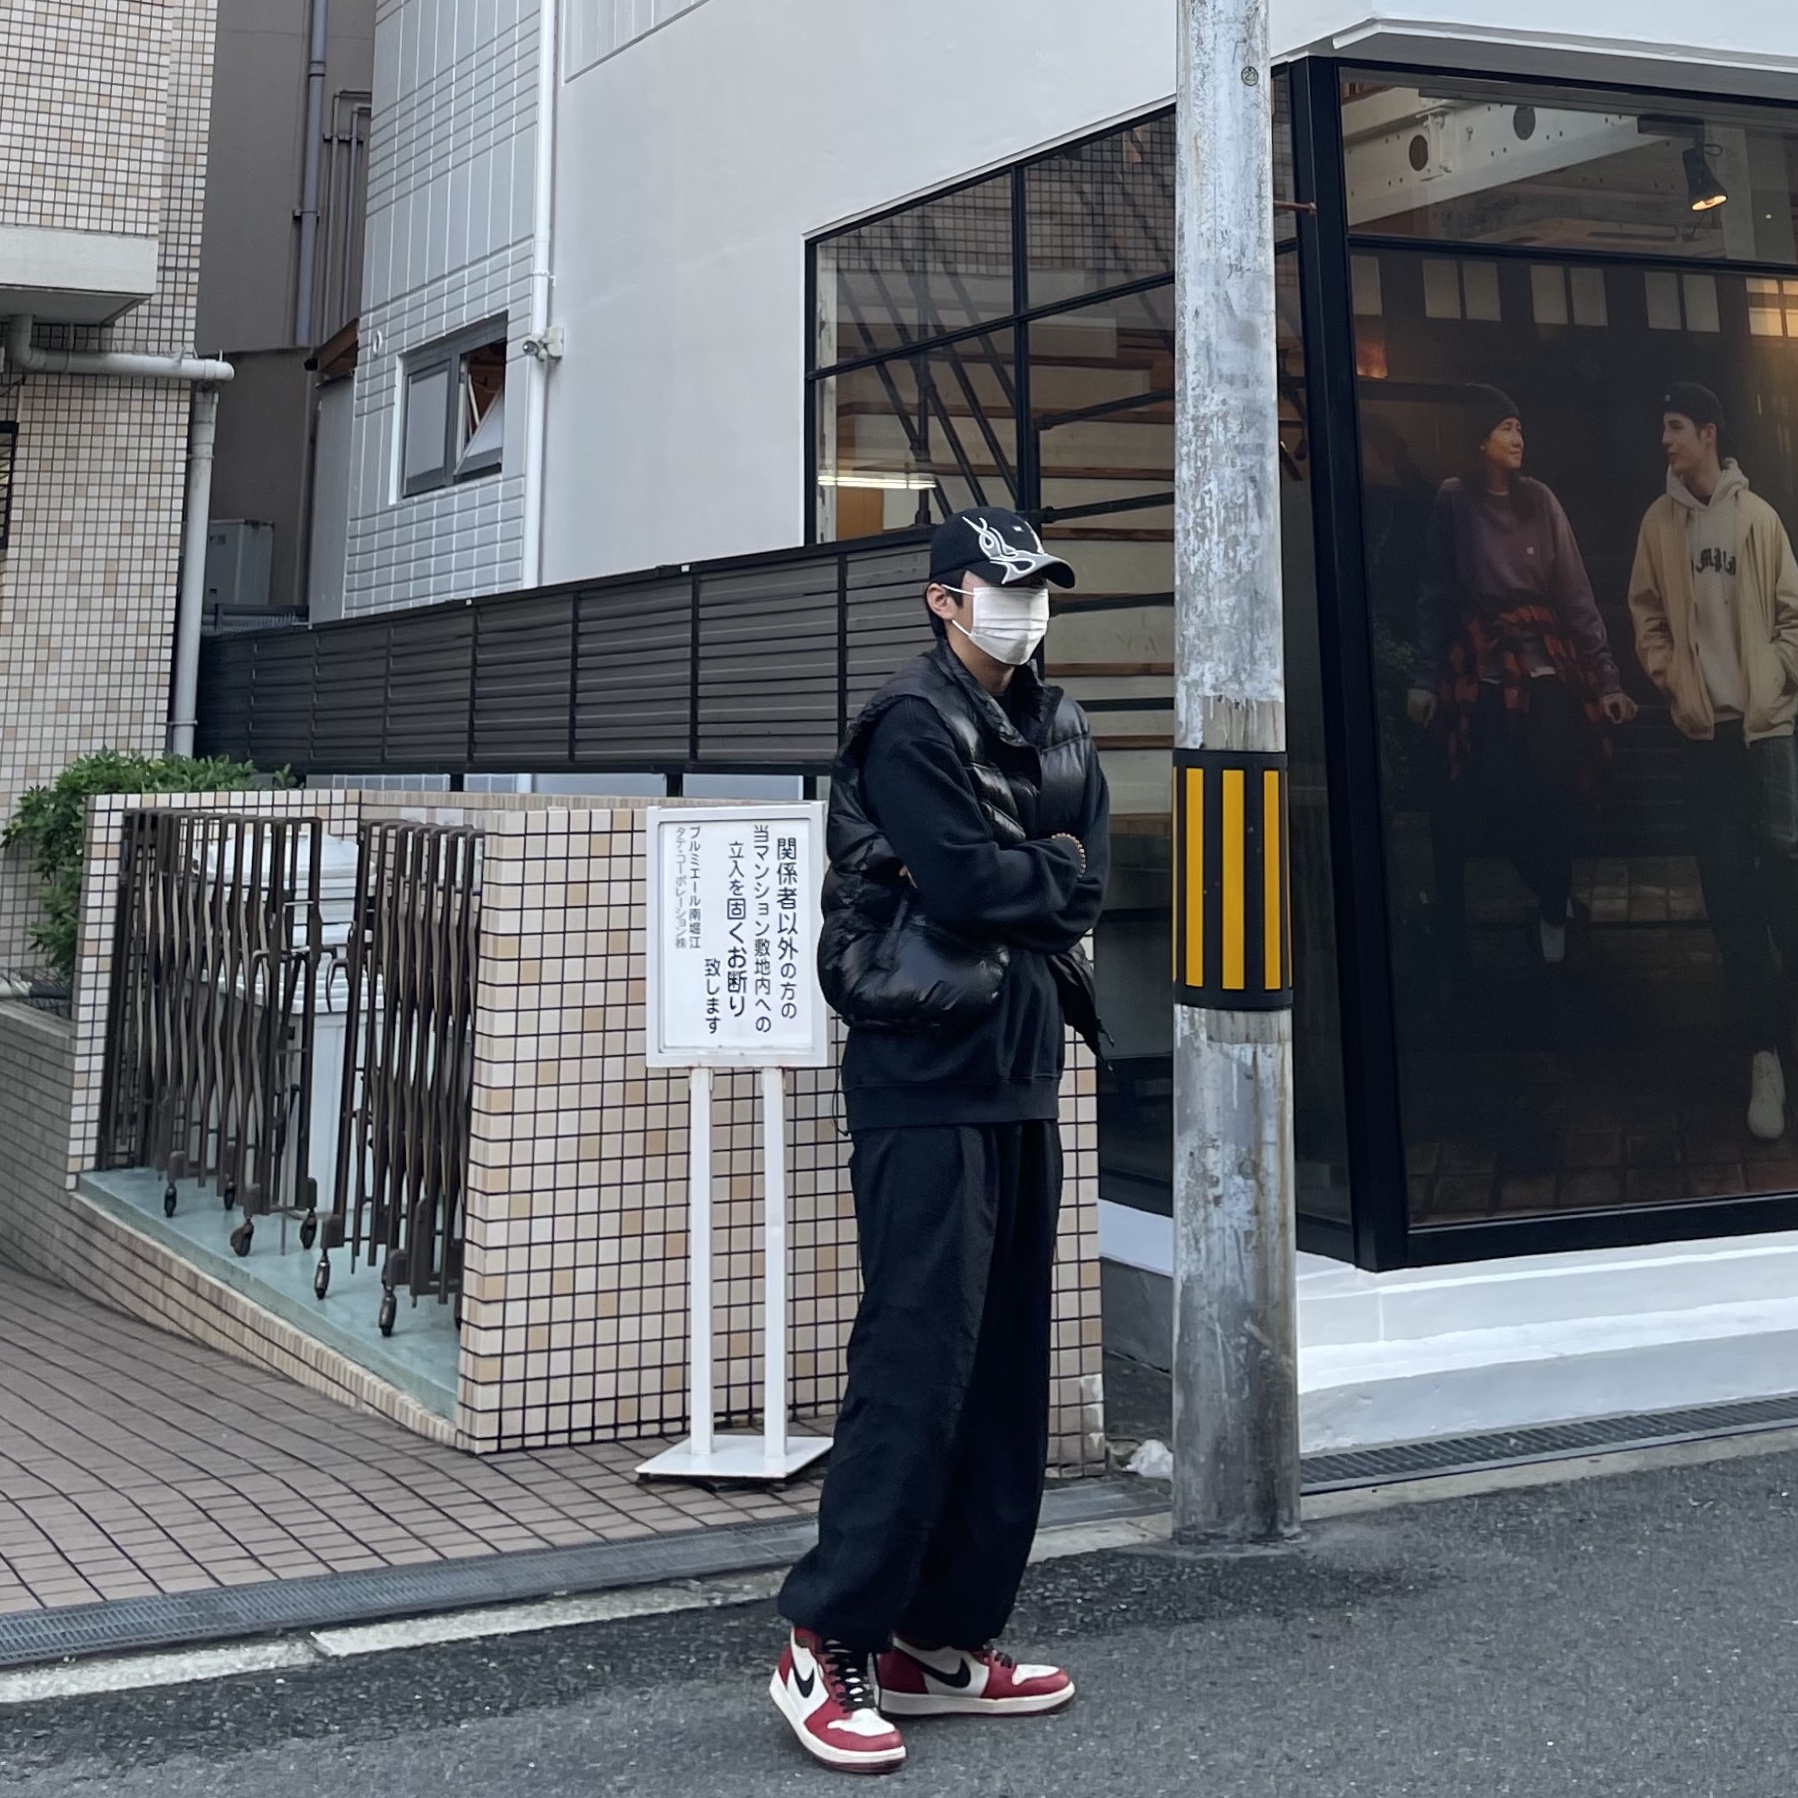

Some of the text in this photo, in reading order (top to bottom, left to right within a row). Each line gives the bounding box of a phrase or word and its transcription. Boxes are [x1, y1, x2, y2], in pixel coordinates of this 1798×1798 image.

[704, 957, 721, 1035] 致します
[727, 841, 748, 1018] 立入を固くお断り
[753, 824, 772, 1033] 当マンション敷地内への
[777, 837, 799, 1020] 関係者以外の方の
